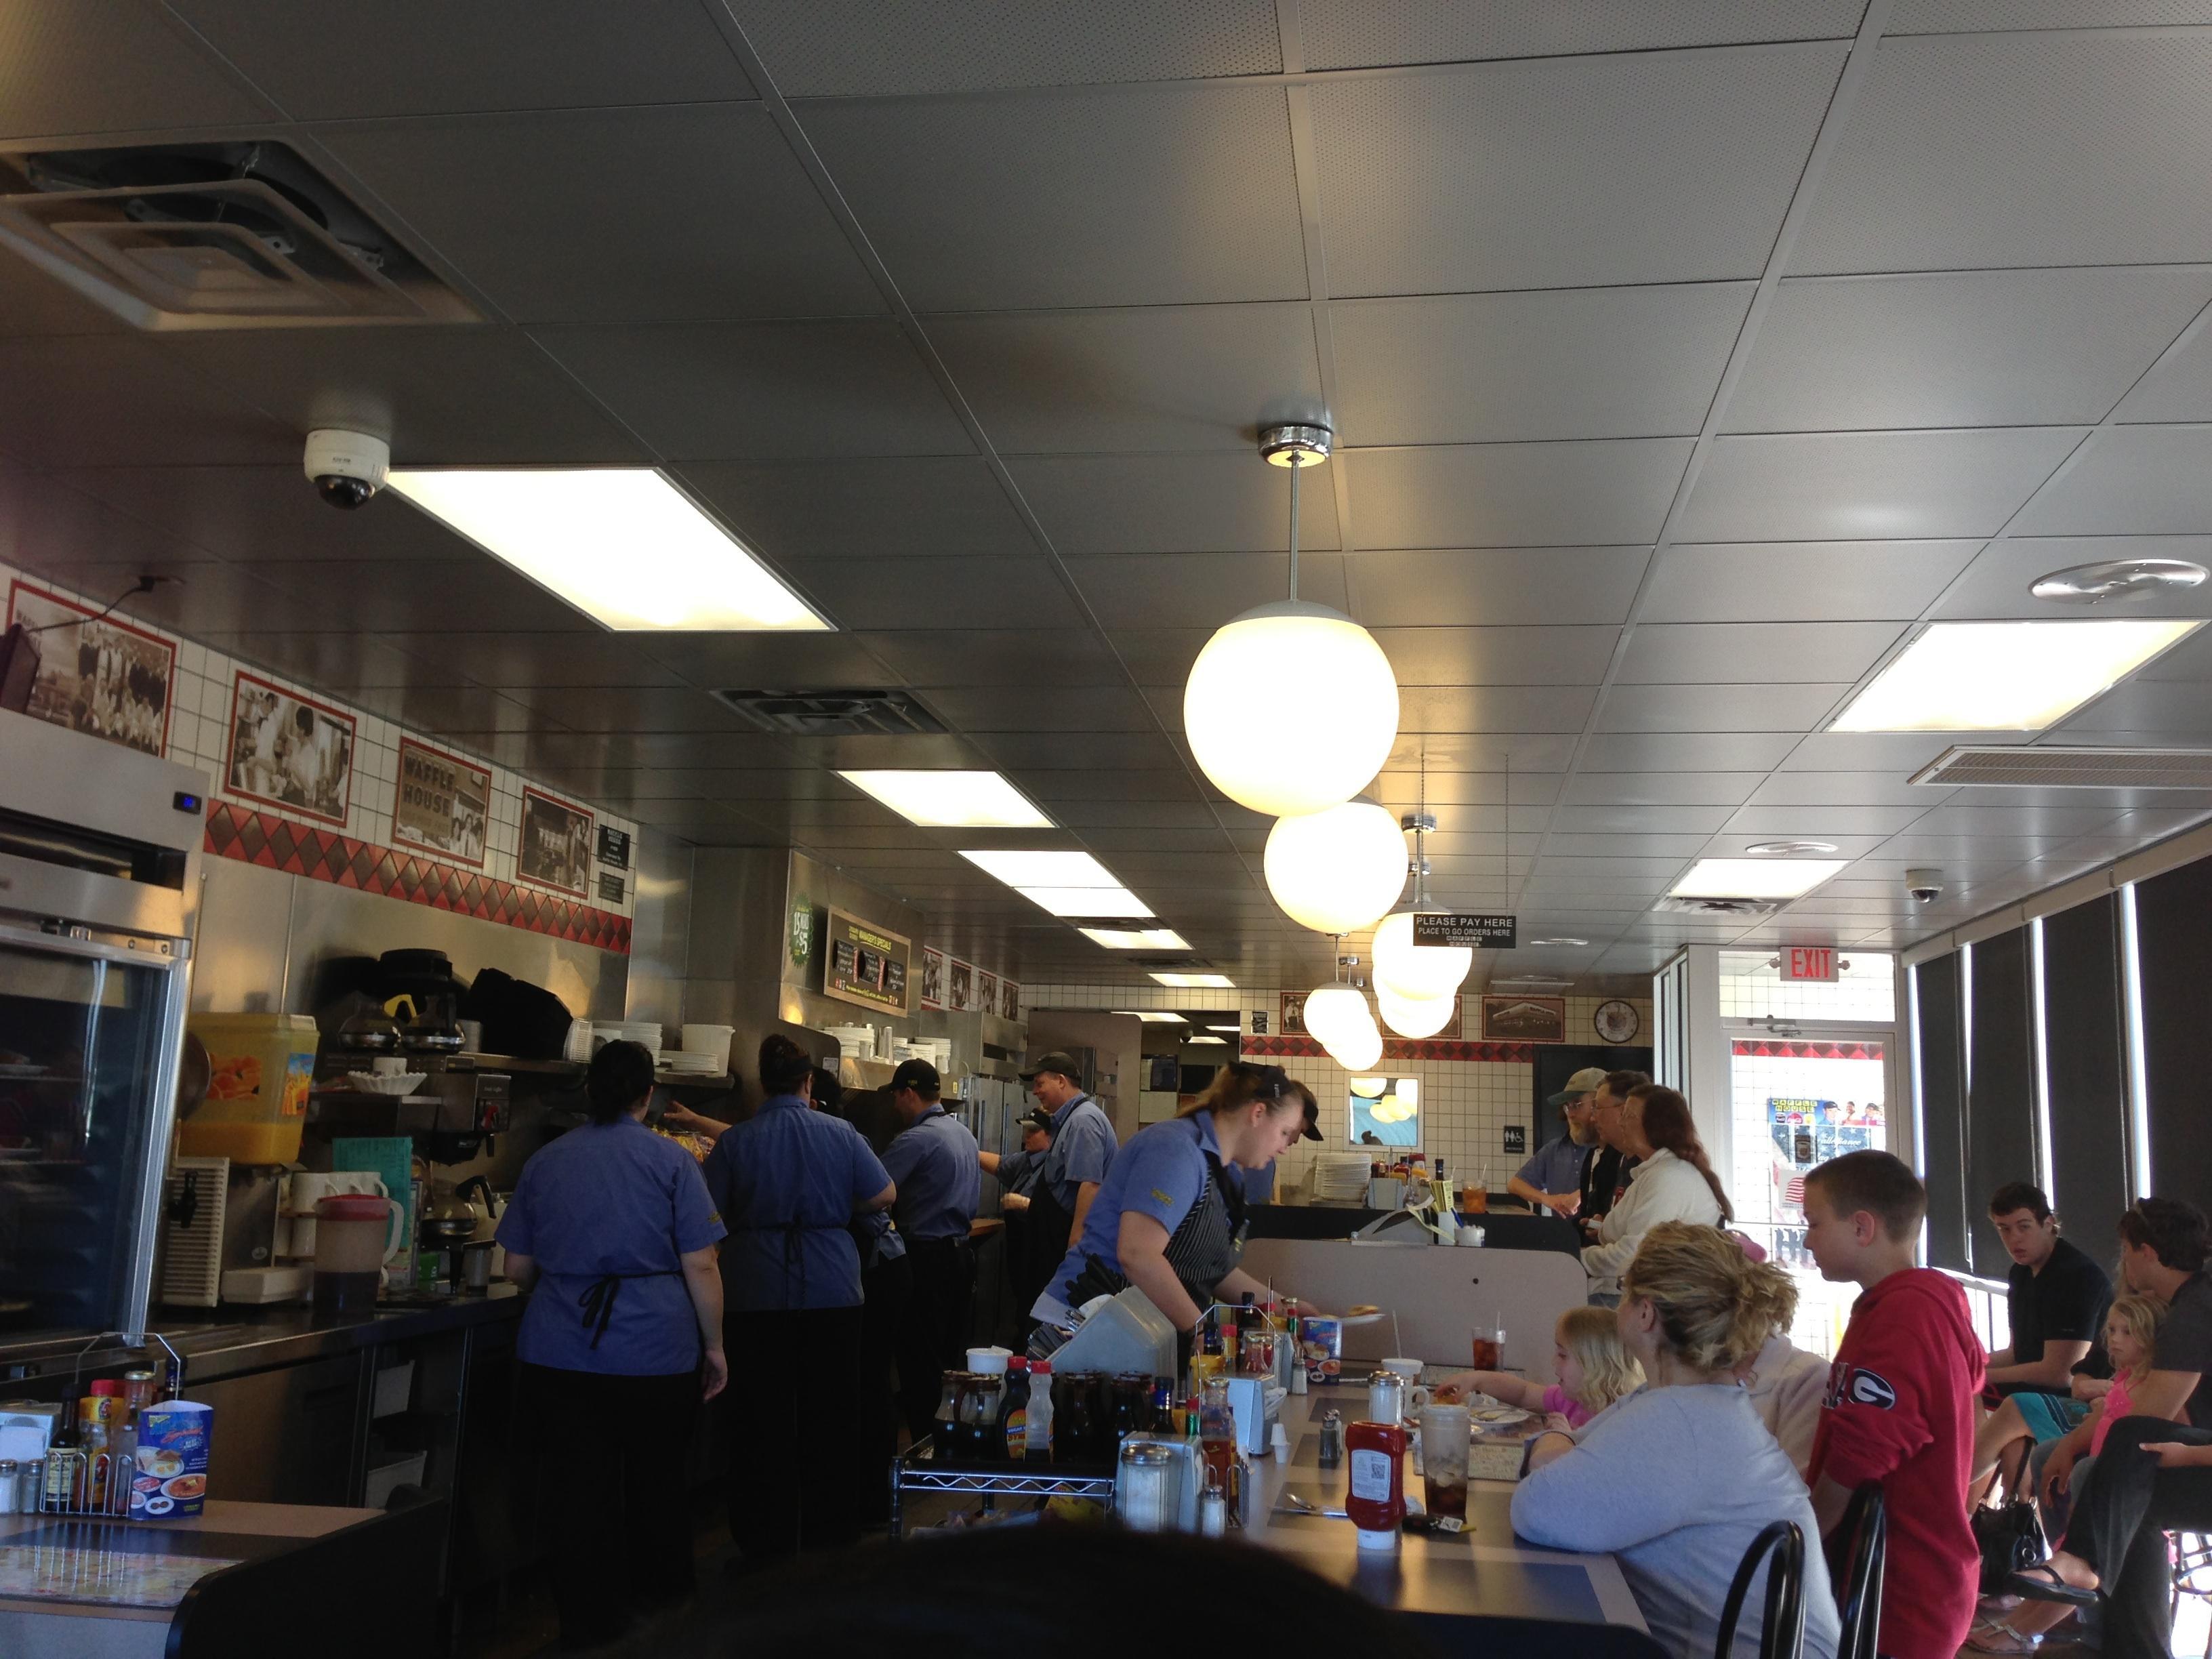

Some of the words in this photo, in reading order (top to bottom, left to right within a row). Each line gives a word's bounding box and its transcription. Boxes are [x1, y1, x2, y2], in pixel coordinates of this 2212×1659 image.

[405, 755, 455, 792] WAFFLE
[403, 783, 451, 817] HOUSE
[1416, 917, 1456, 926] PLEASE
[1460, 918, 1481, 926] PAY
[1484, 919, 1513, 927] HERE
[1418, 927, 1439, 935] PLACE
[1791, 949, 1830, 978] EXIT
